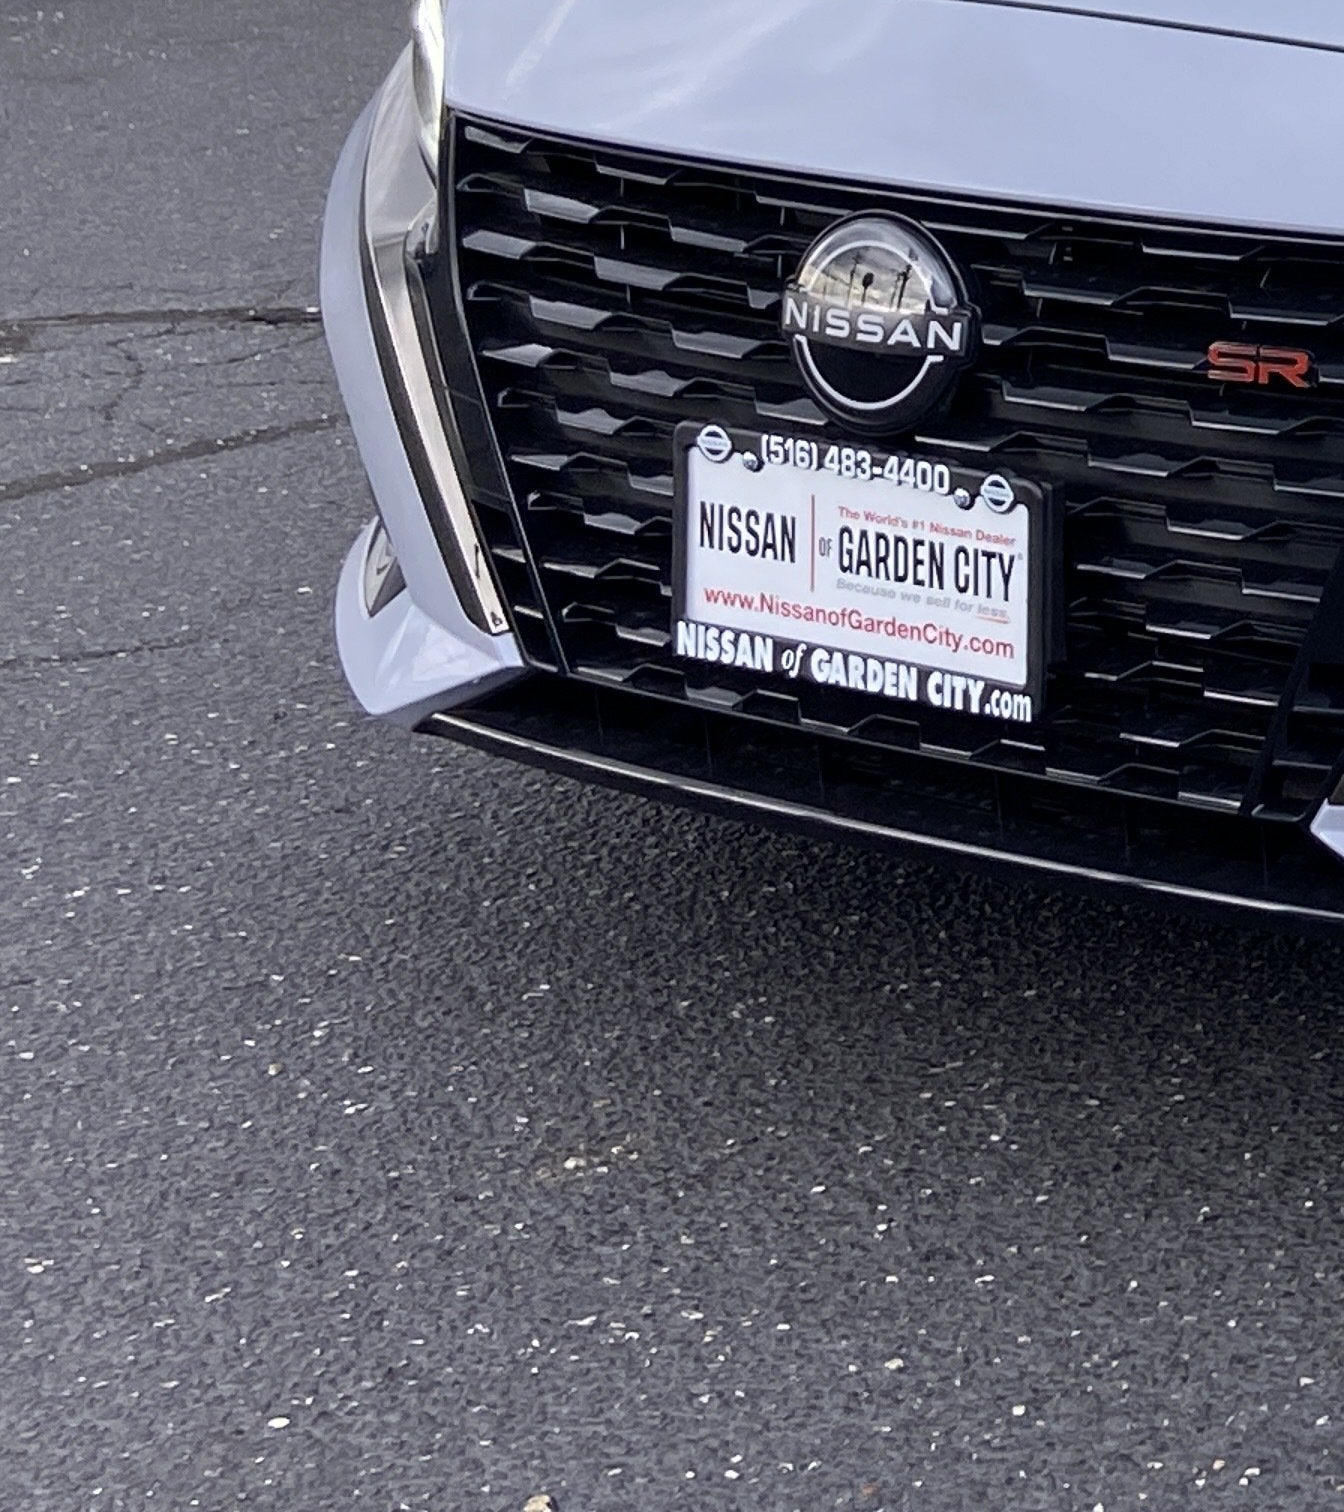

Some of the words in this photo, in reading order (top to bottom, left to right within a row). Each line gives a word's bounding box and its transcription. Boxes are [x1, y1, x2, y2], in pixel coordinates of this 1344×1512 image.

[784, 298, 962, 351] NISSAN
[1207, 340, 1311, 388] SR
[761, 434, 818, 472] (516)
[823, 445, 951, 495] 483-4400
[699, 500, 797, 563] NISSAN
[818, 536, 833, 558] OF
[838, 525, 945, 591] GARDEN
[953, 545, 1016, 603] CITY
[838, 506, 860, 520] The
[863, 511, 908, 529] World's
[912, 519, 925, 530] #1
[929, 522, 972, 538] Nissan
[975, 529, 1016, 546] Dealer
[836, 578, 896, 599] Because
[901, 593, 921, 604] we
[926, 596, 951, 609] sell
[954, 599, 974, 612] for
[703, 588, 1015, 660] www.NissanofGardenCity.com
[677, 621, 773, 673] NISSAN
[781, 643, 808, 678] of
[810, 647, 918, 702] GARDEN
[926, 671, 1033, 723] CITY.com
